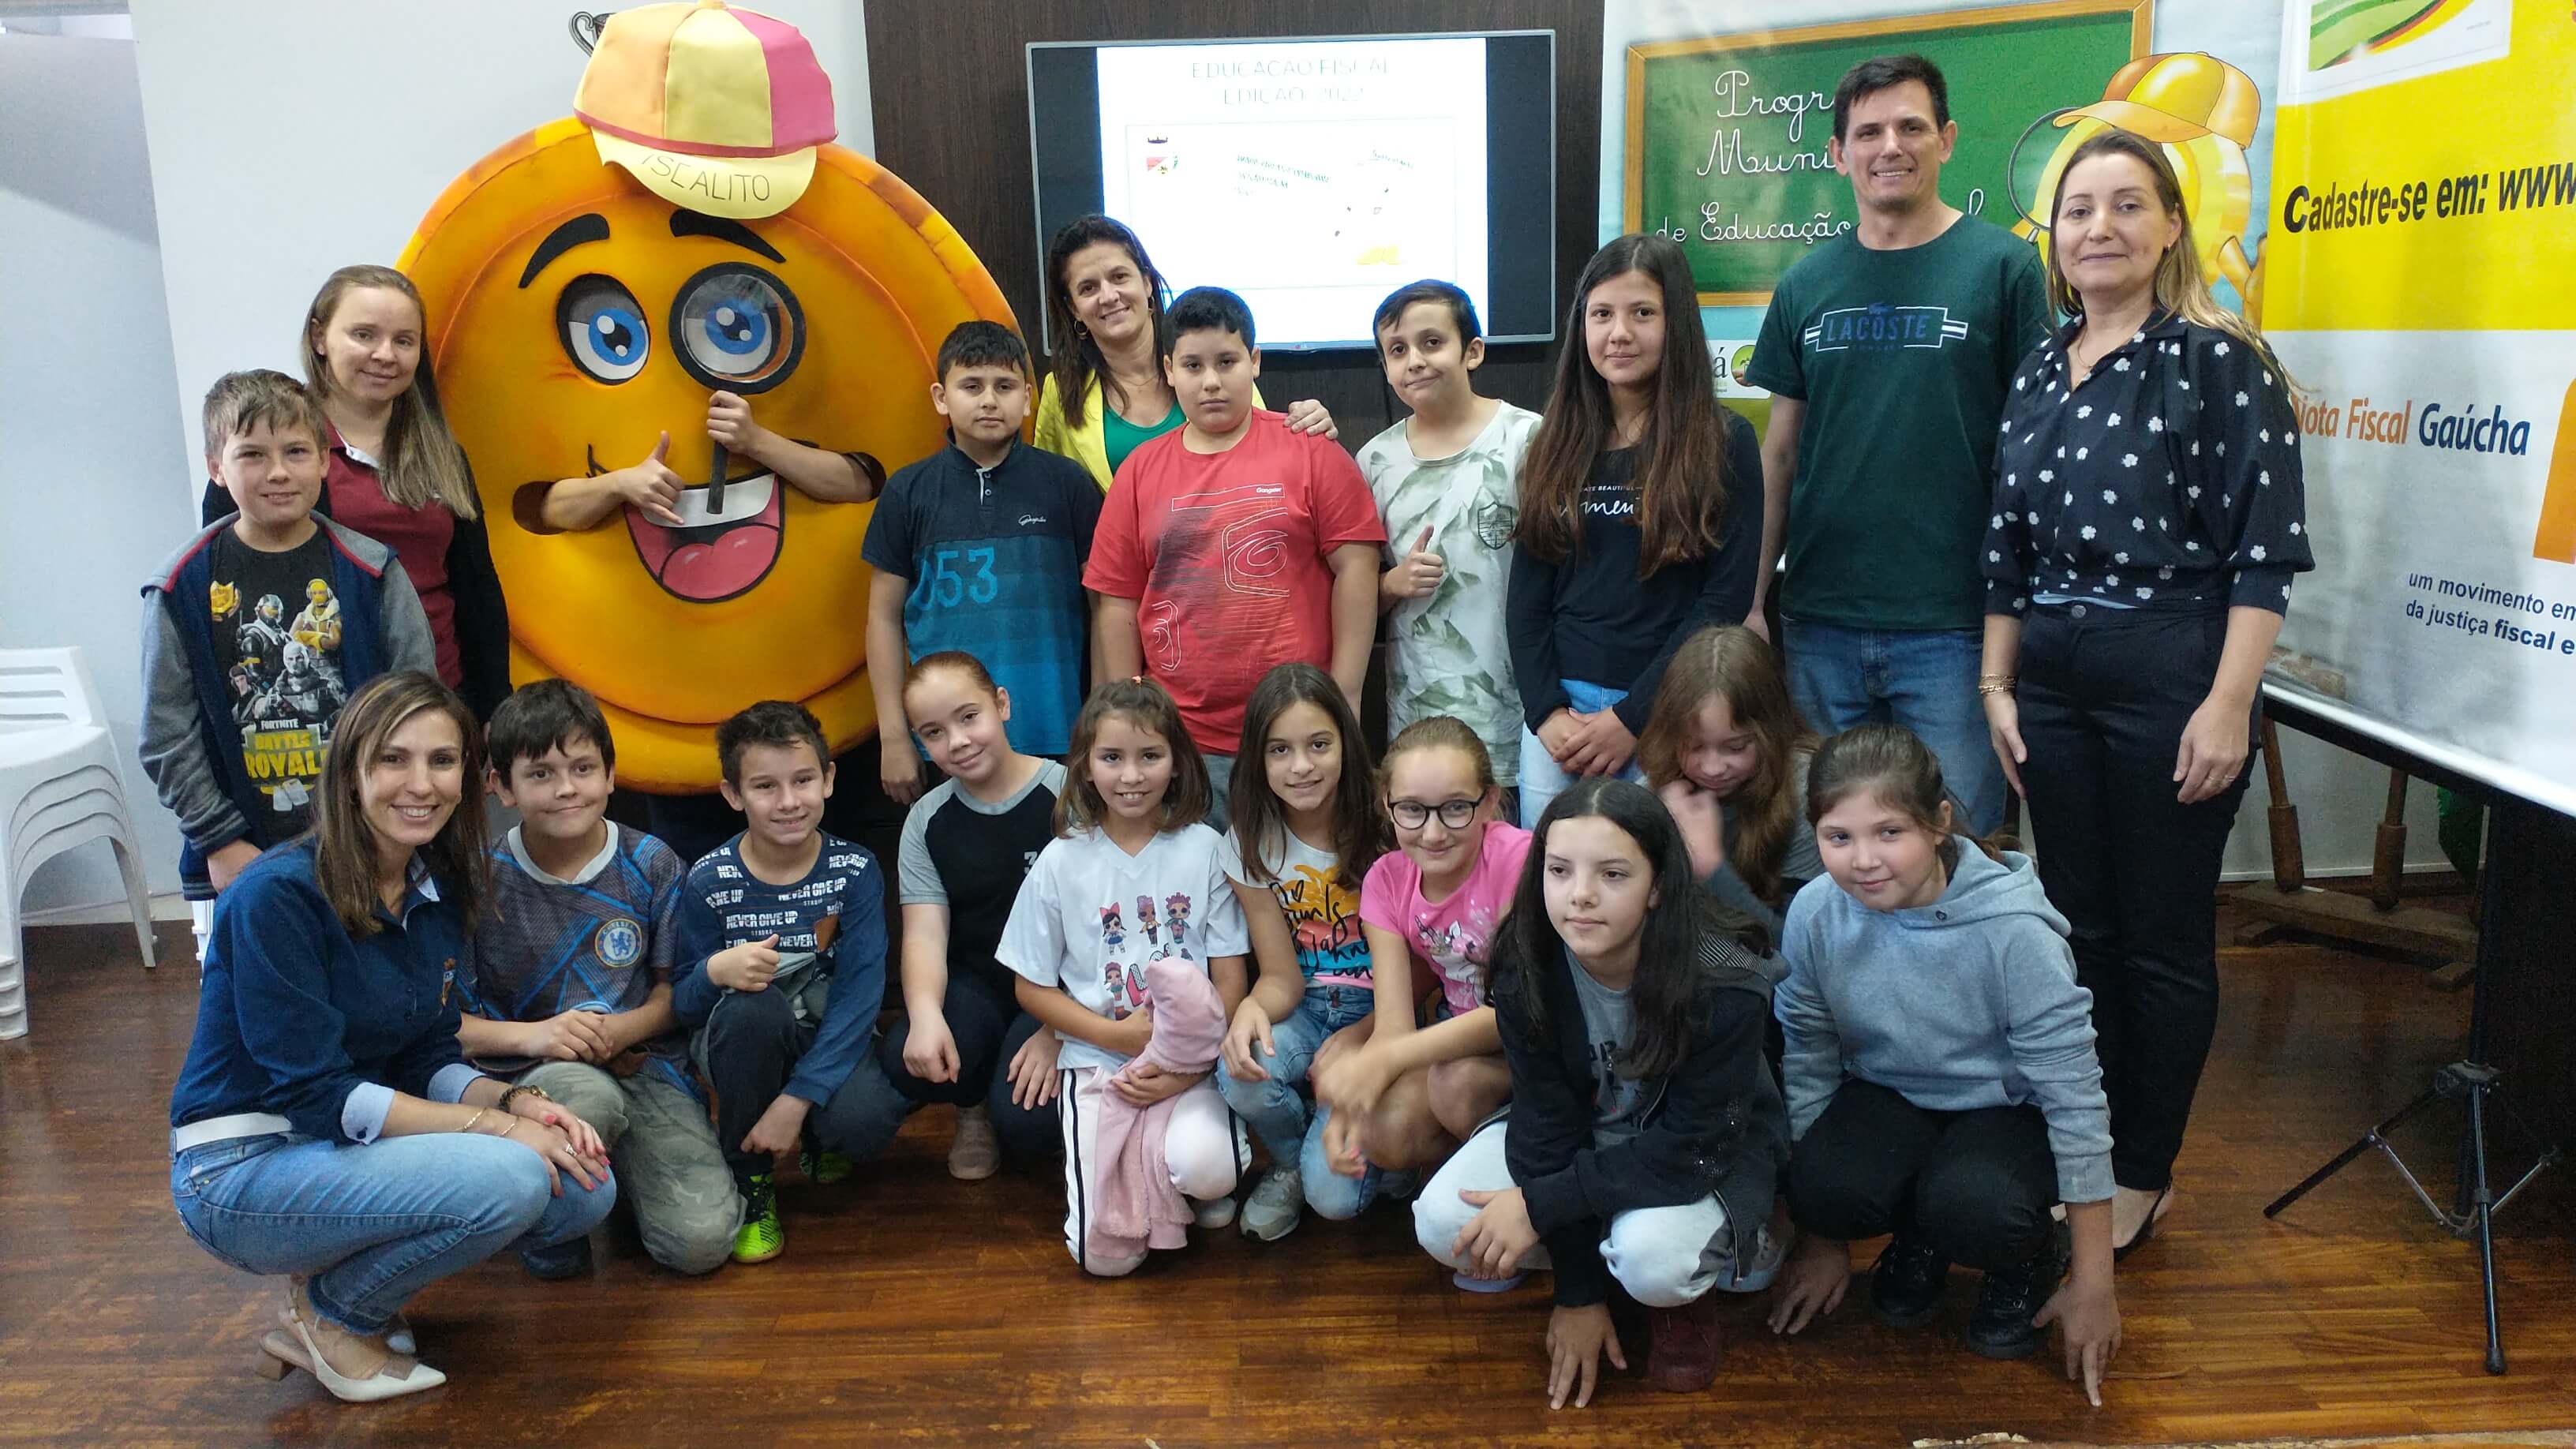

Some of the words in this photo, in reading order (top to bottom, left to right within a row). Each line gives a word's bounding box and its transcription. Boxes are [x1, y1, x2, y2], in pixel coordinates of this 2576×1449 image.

[1715, 70, 1835, 142] Progr
[1697, 128, 1837, 176] Muni
[2284, 179, 2428, 234] Cadastre-se
[2436, 172, 2489, 218] em:
[1826, 314, 1930, 343] LACOSTE
[2346, 397, 2413, 444] Fiscal
[2418, 402, 2531, 455] Gaúcha
[2409, 573, 2433, 591] um
[2438, 582, 2544, 615] movimento
[2406, 600, 2424, 620] da
[2426, 605, 2488, 636] justiça
[2494, 618, 2556, 651] fiscal
[261, 719, 298, 729] FORTNITE
[731, 889, 744, 903] UP
[812, 879, 833, 897] GIVE
[834, 877, 847, 892] UP
[726, 914, 758, 930] NEVER
[758, 912, 784, 927] GIVE
[784, 911, 799, 924] UP
[779, 934, 814, 948] NEVER
